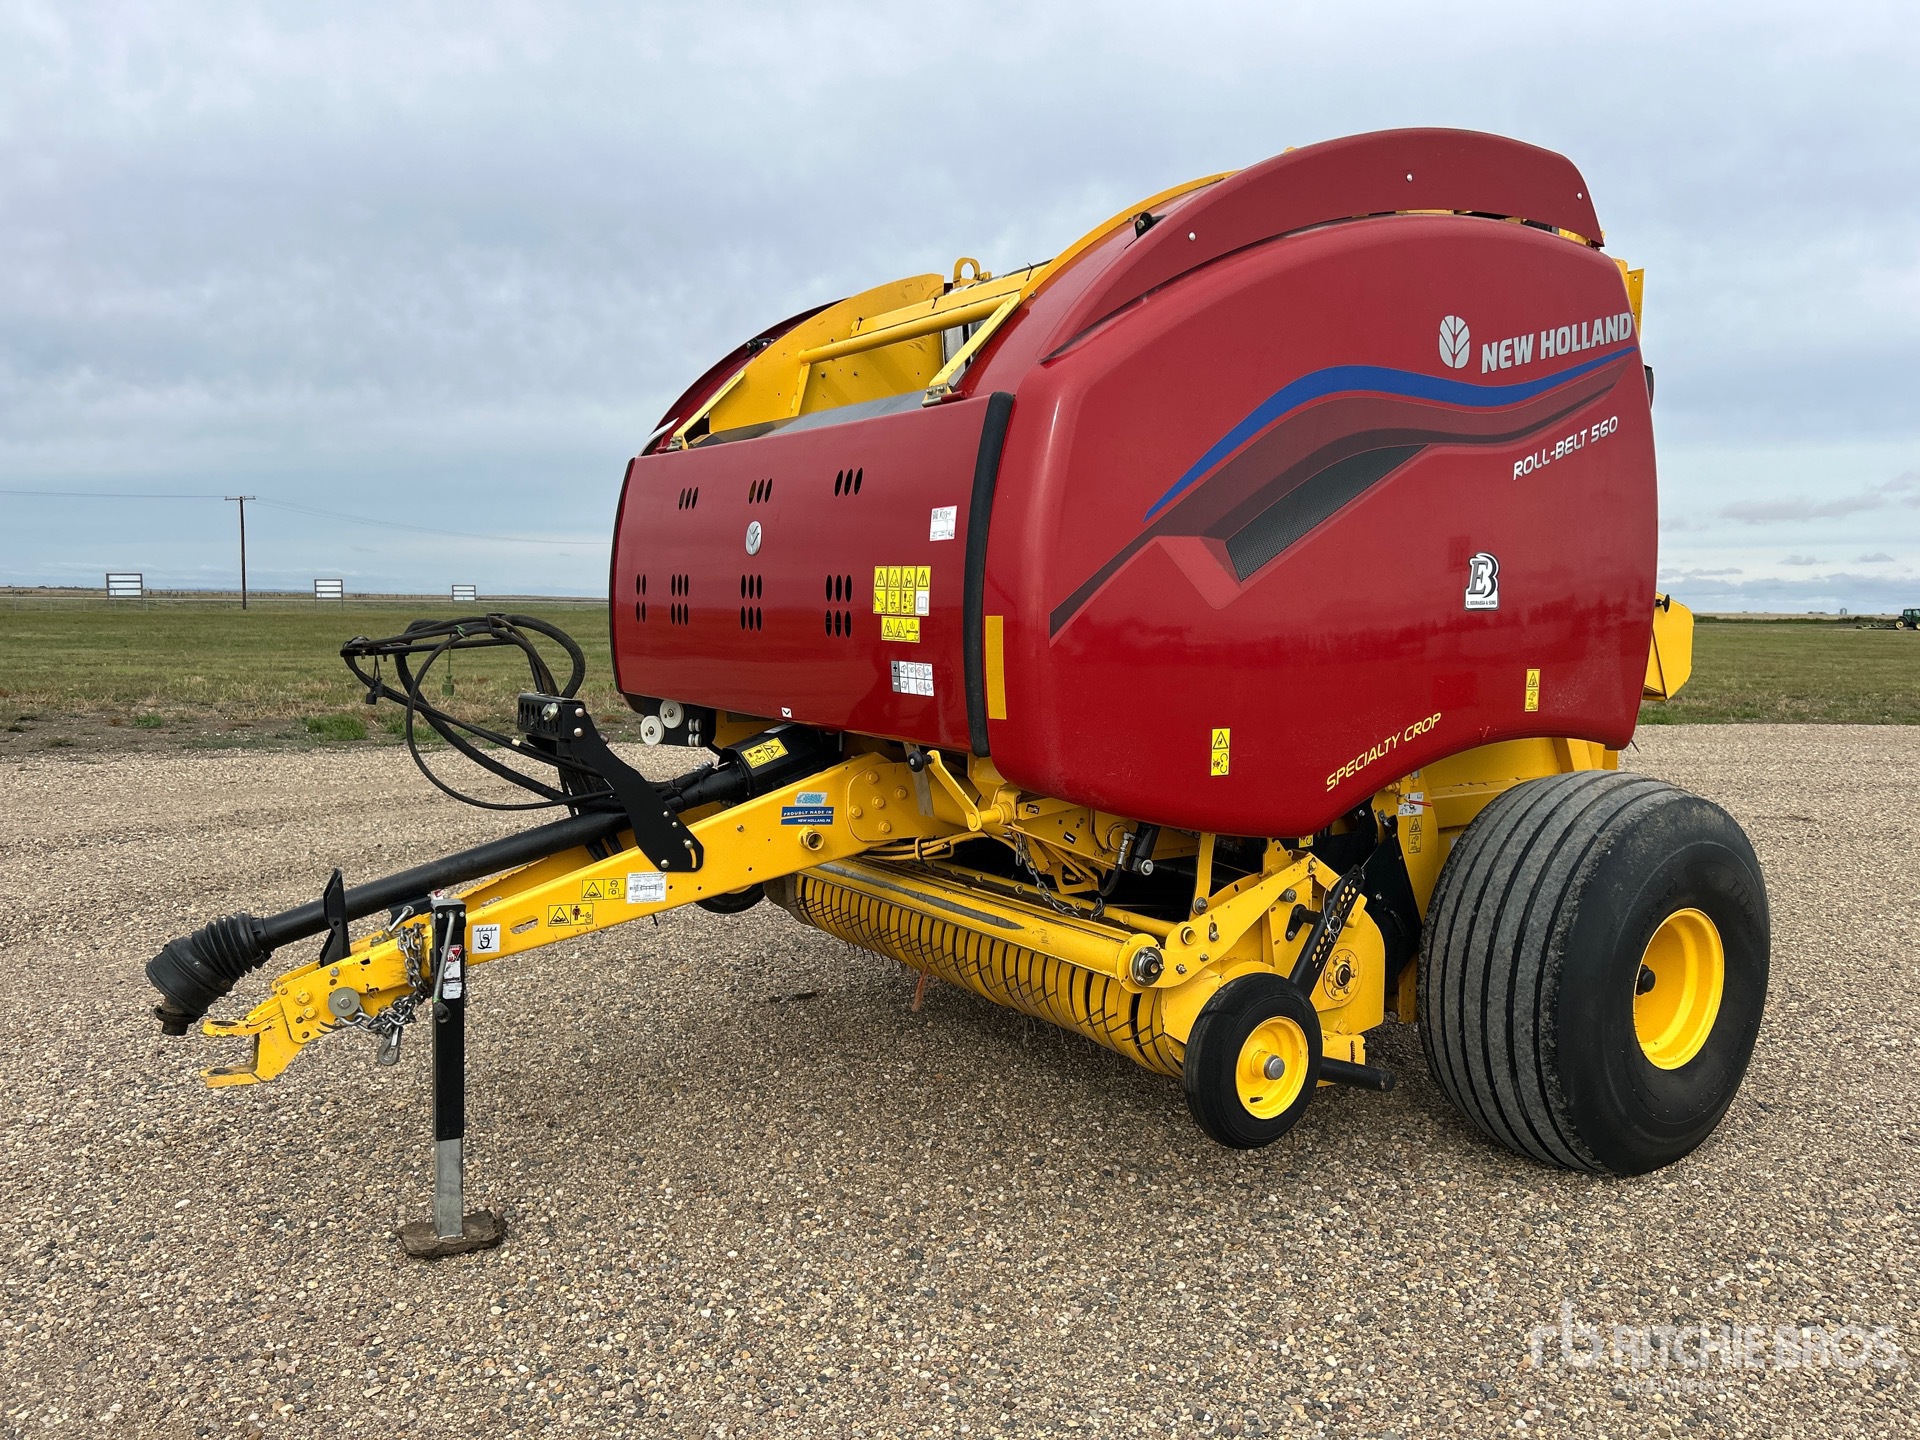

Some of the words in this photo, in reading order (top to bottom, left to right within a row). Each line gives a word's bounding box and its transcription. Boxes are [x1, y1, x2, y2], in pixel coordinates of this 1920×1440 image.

[1481, 334, 1534, 374] NEW
[1540, 312, 1632, 360] HOLLAND
[1513, 429, 1588, 480] ROLL-BELT
[1591, 415, 1619, 444] 560
[1326, 732, 1401, 793] SPECIALTY
[1404, 712, 1442, 742] CROP
